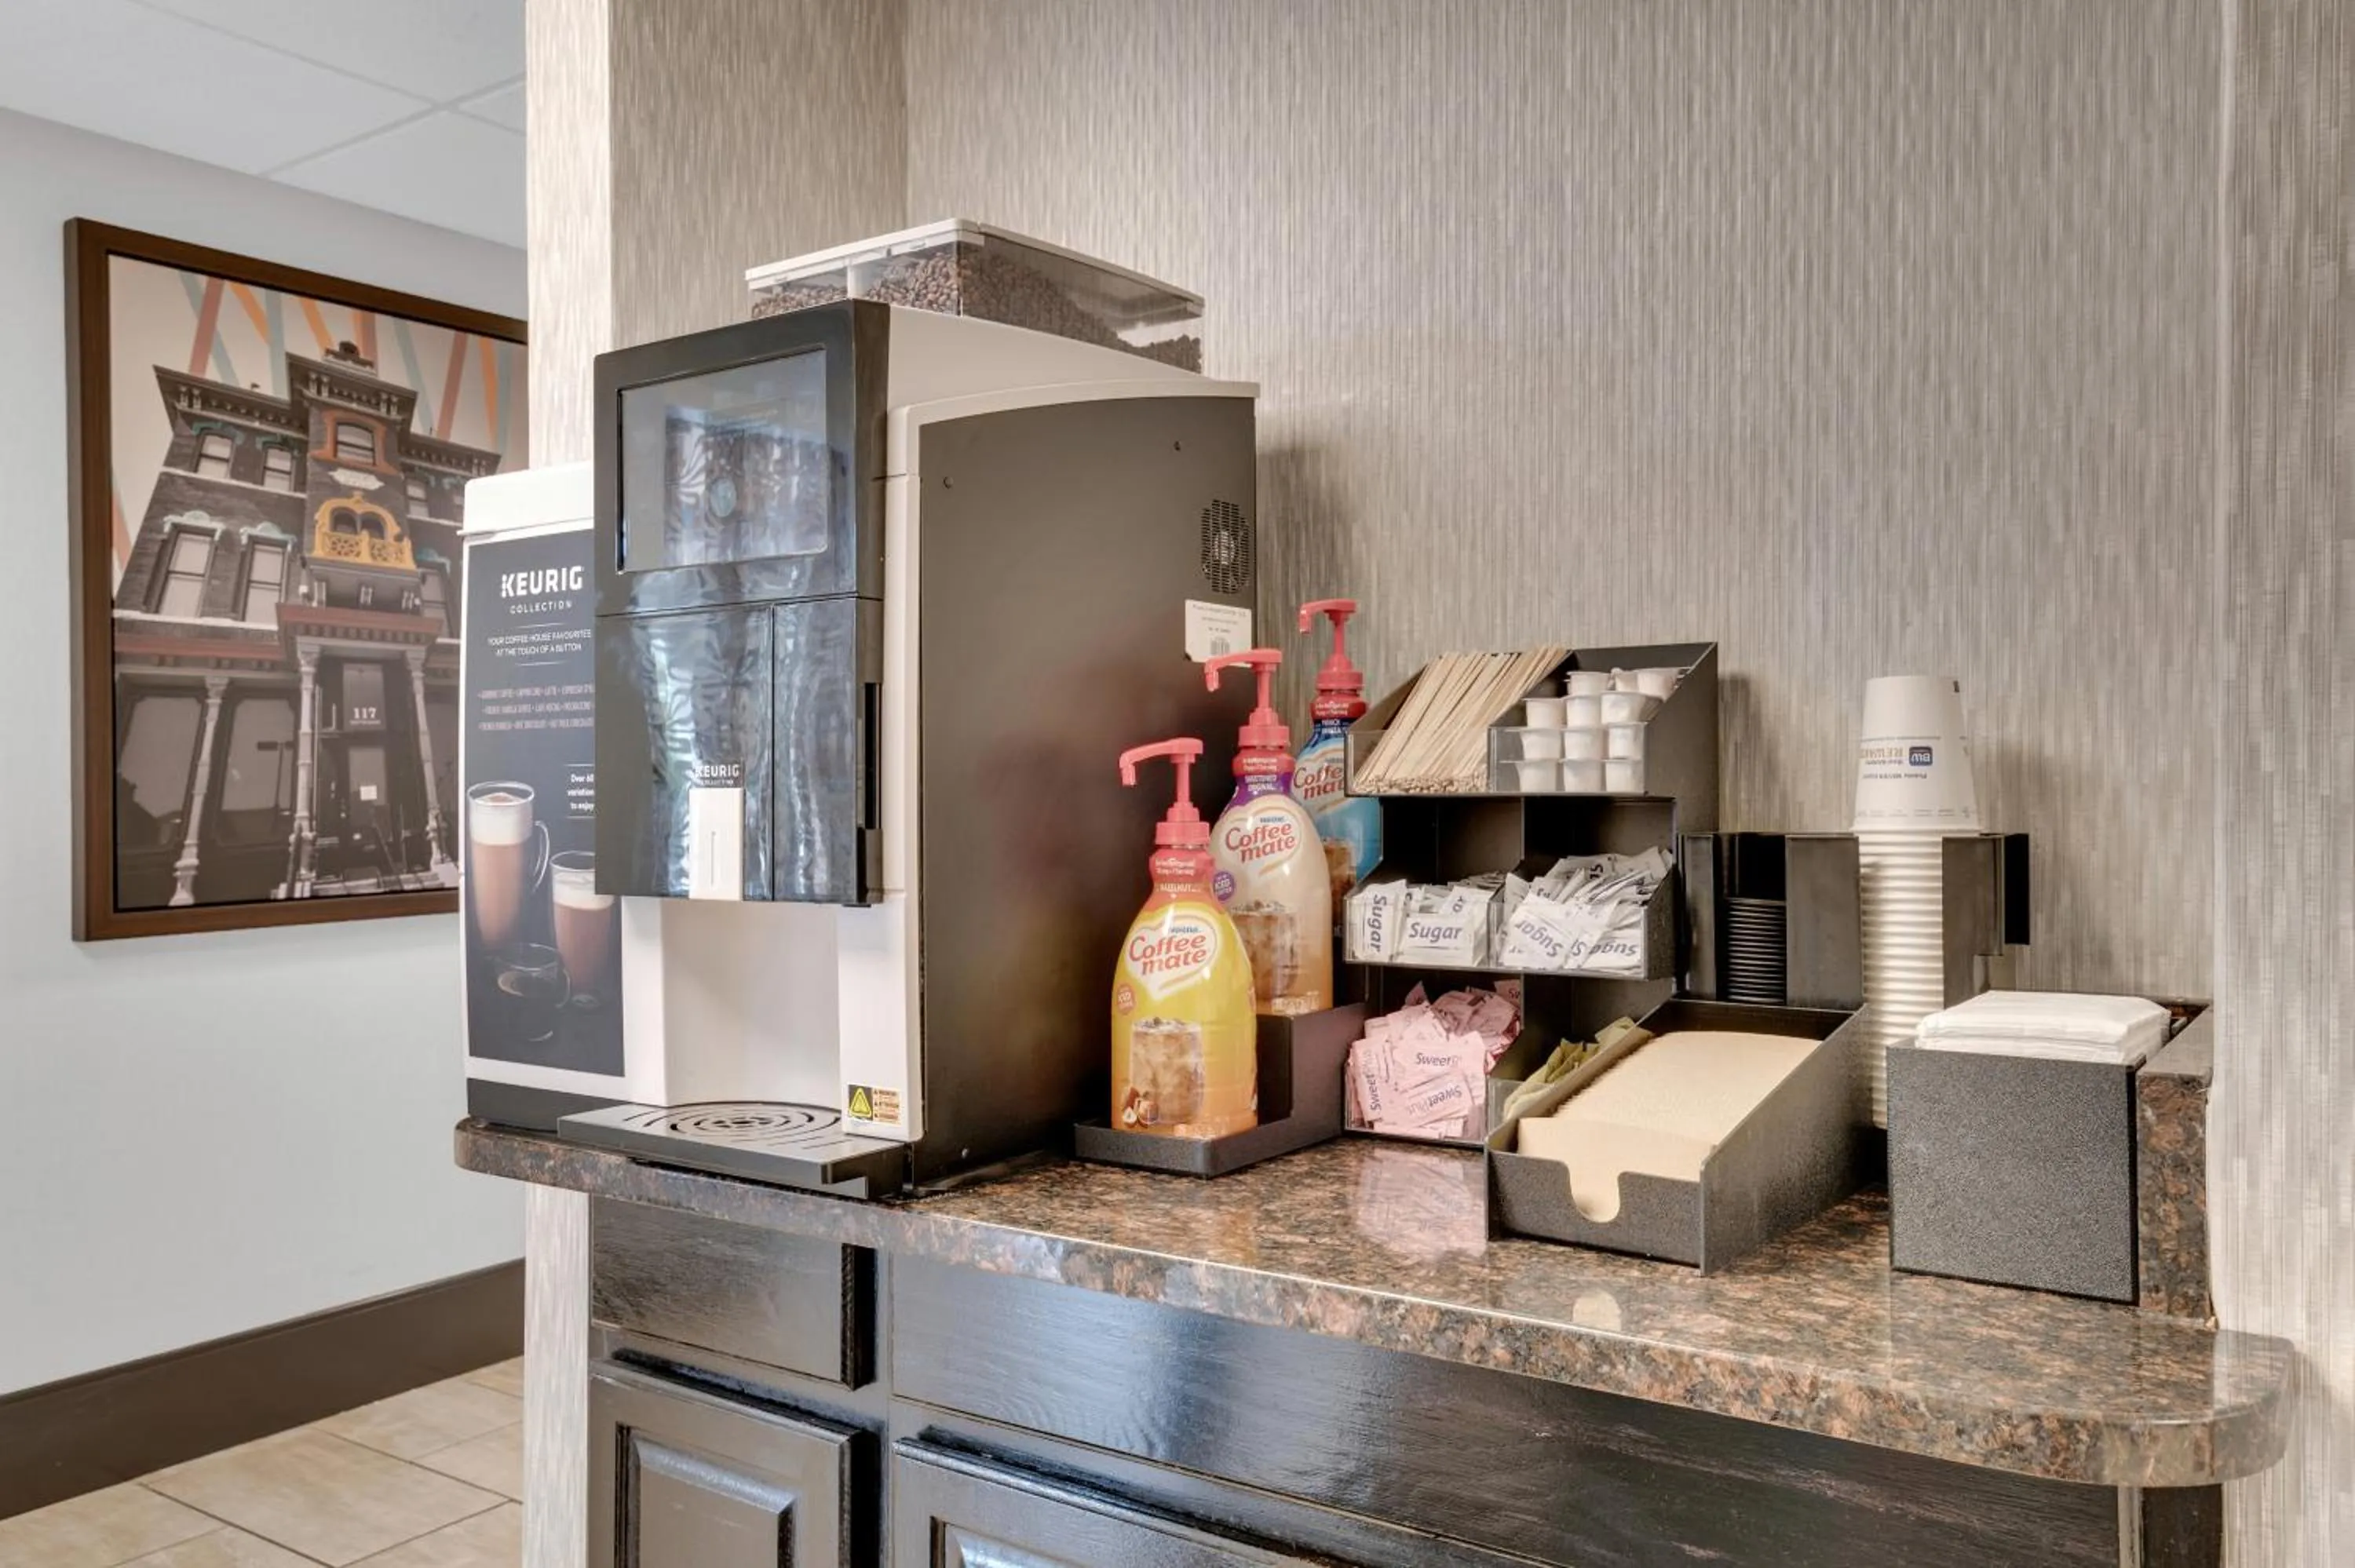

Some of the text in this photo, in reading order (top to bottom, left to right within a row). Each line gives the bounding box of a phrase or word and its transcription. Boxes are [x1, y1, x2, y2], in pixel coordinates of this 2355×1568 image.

[501, 565, 582, 598] KEURIG
[509, 600, 572, 614] COLLECTION
[353, 707, 377, 719] 117
[695, 764, 739, 778] KEURIG
[1294, 765, 1342, 788] Coffe
[1303, 781, 1343, 799] mat
[1225, 824, 1292, 851] Coffee
[1240, 836, 1295, 863] mate
[1367, 895, 1387, 952] Sugar
[1409, 922, 1464, 943] Sugar
[1129, 934, 1207, 962] Coffee
[1515, 919, 1564, 957] Sugar
[1589, 940, 1638, 956] Suga
[1141, 950, 1207, 975] mate
